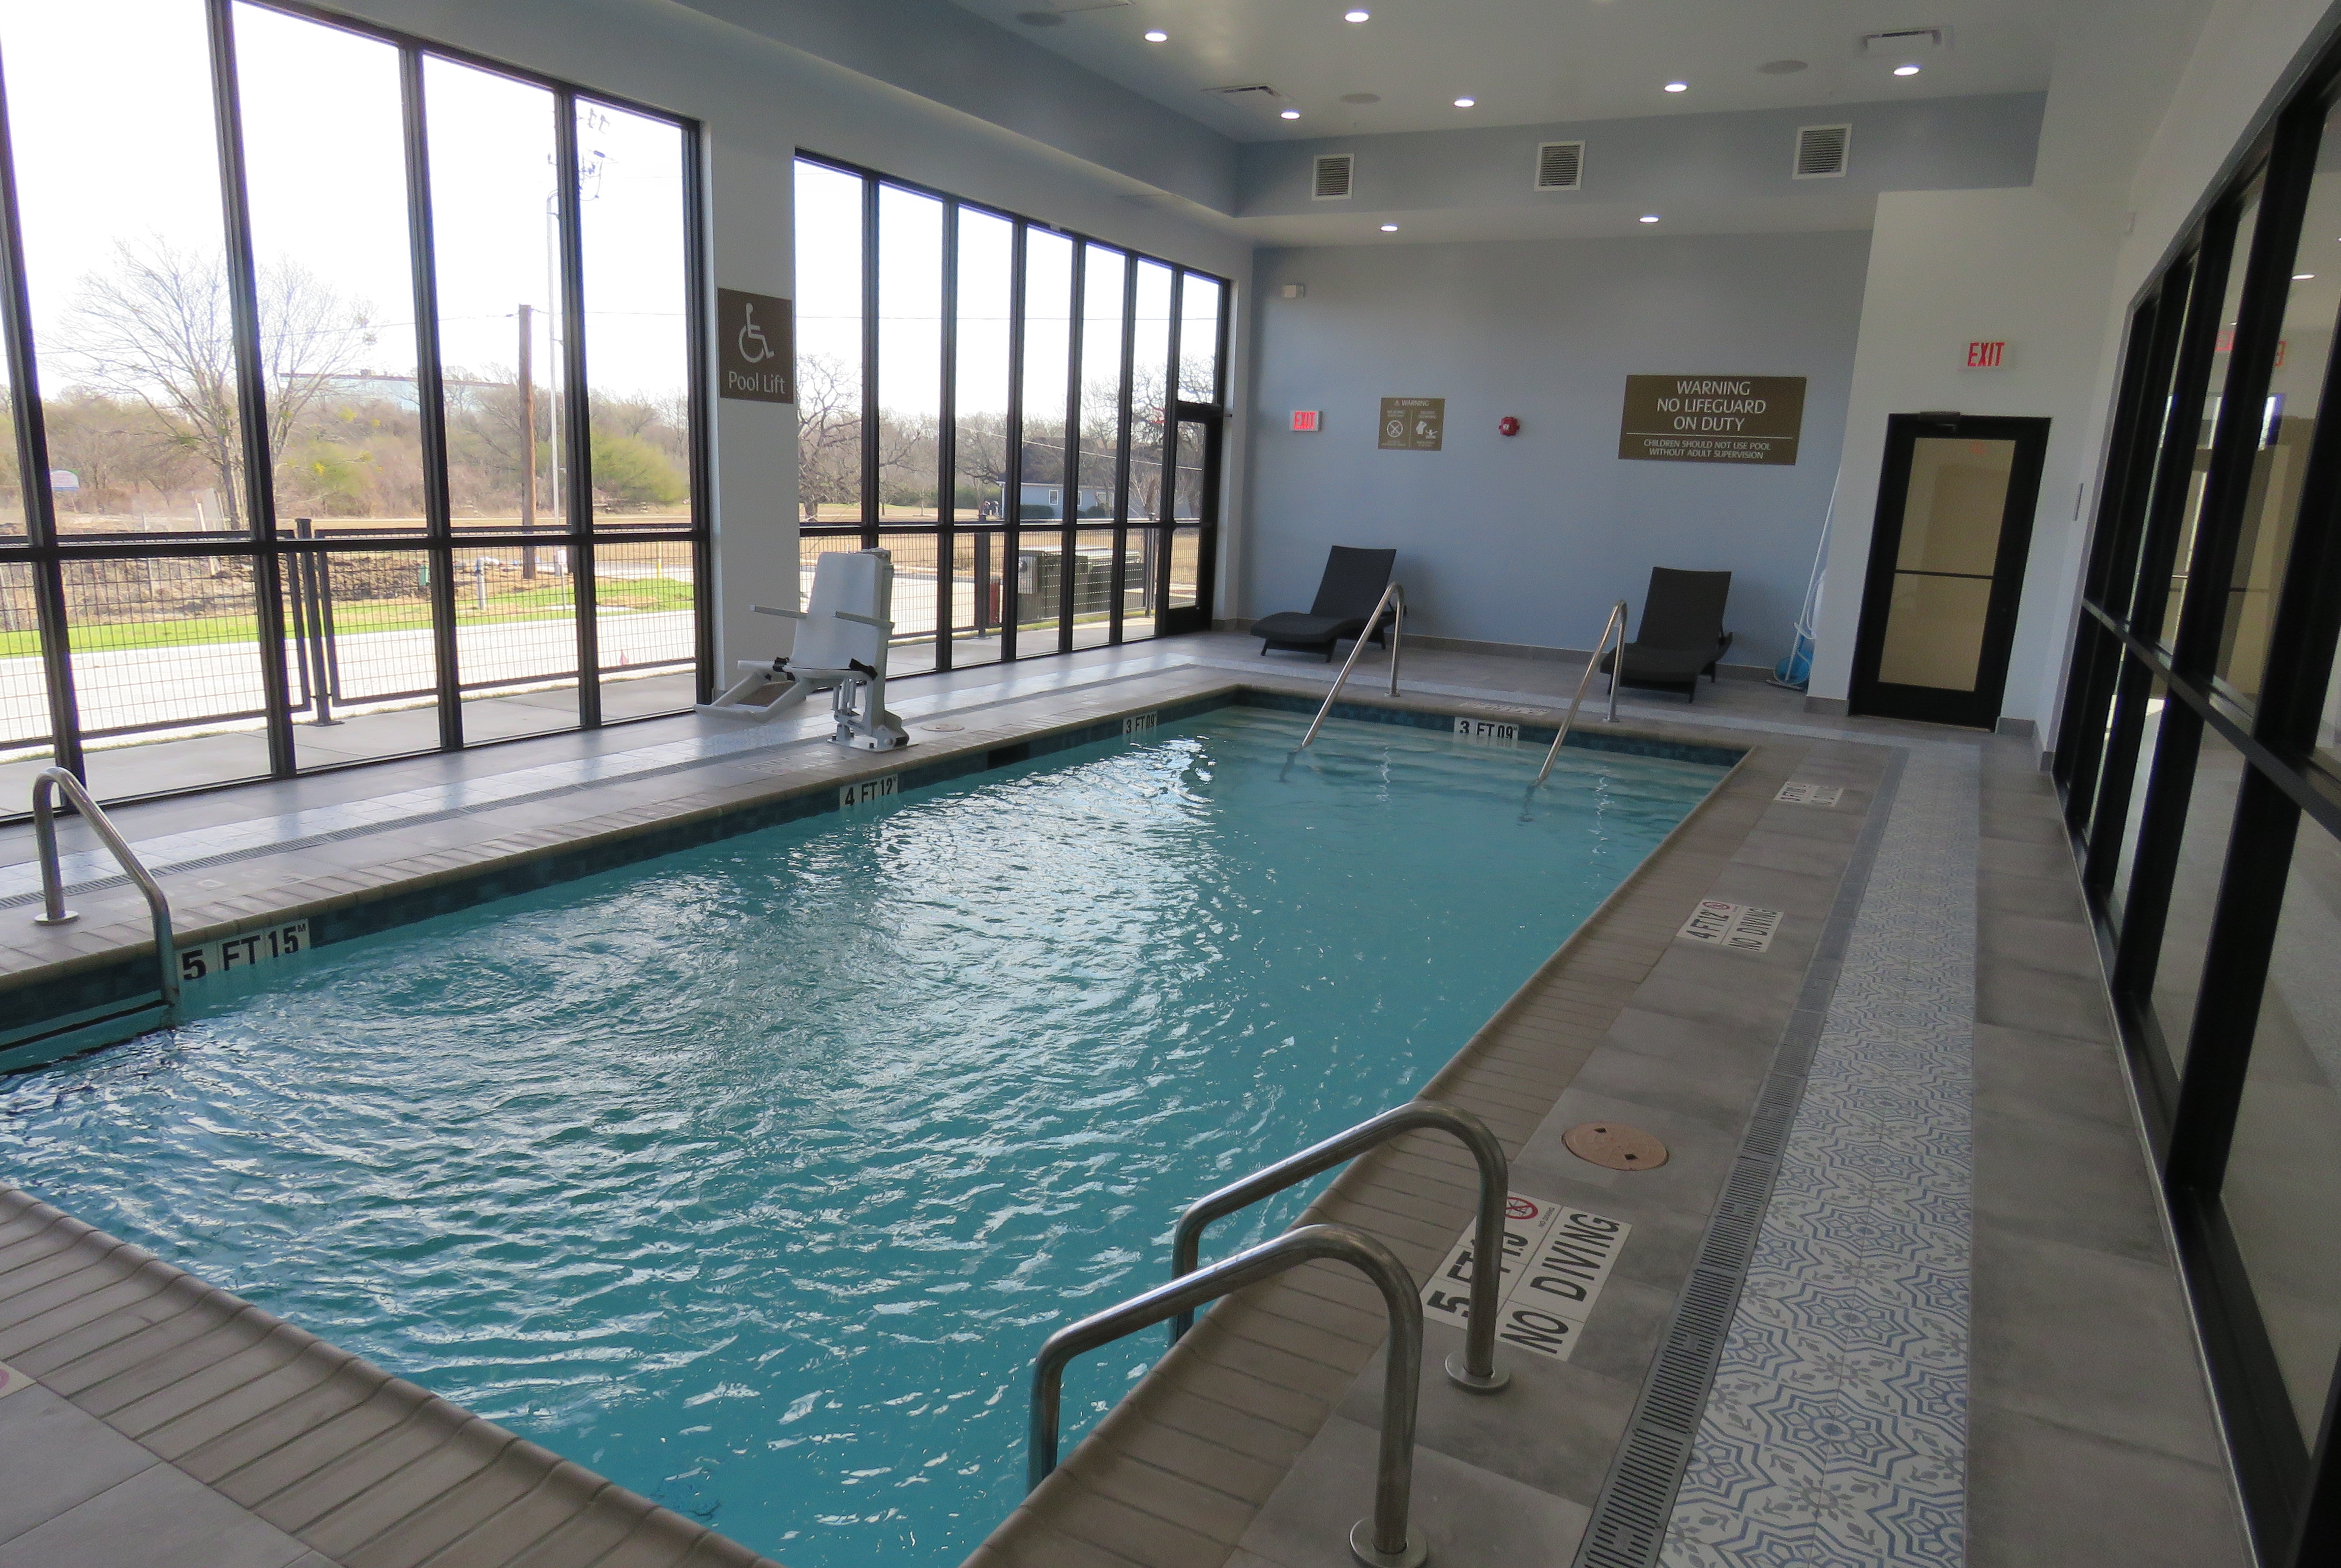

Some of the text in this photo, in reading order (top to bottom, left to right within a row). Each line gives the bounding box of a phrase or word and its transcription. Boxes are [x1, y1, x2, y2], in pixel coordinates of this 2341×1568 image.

[1967, 342, 2005, 367] EXIT
[729, 371, 786, 394] Pool Lift
[1677, 380, 1751, 396] WARNING
[1657, 398, 1766, 414] NO LIFEGUARD
[1294, 411, 1316, 430] EXIT
[1674, 416, 1745, 431] ON DUTY
[1644, 439, 1771, 450] CHILDREN SHOULD NOT USE POOL
[1649, 448, 1685, 456] WITHOUT
[1713, 450, 1764, 459] SUPERVISION
[1136, 715, 1146, 731] FT
[1477, 722, 1495, 737] FT
[845, 787, 855, 806] 4
[861, 781, 877, 803] FT
[182, 949, 207, 981] 5
[222, 934, 261, 971] FT
[1500, 1213, 1620, 1354] NO DIVING
